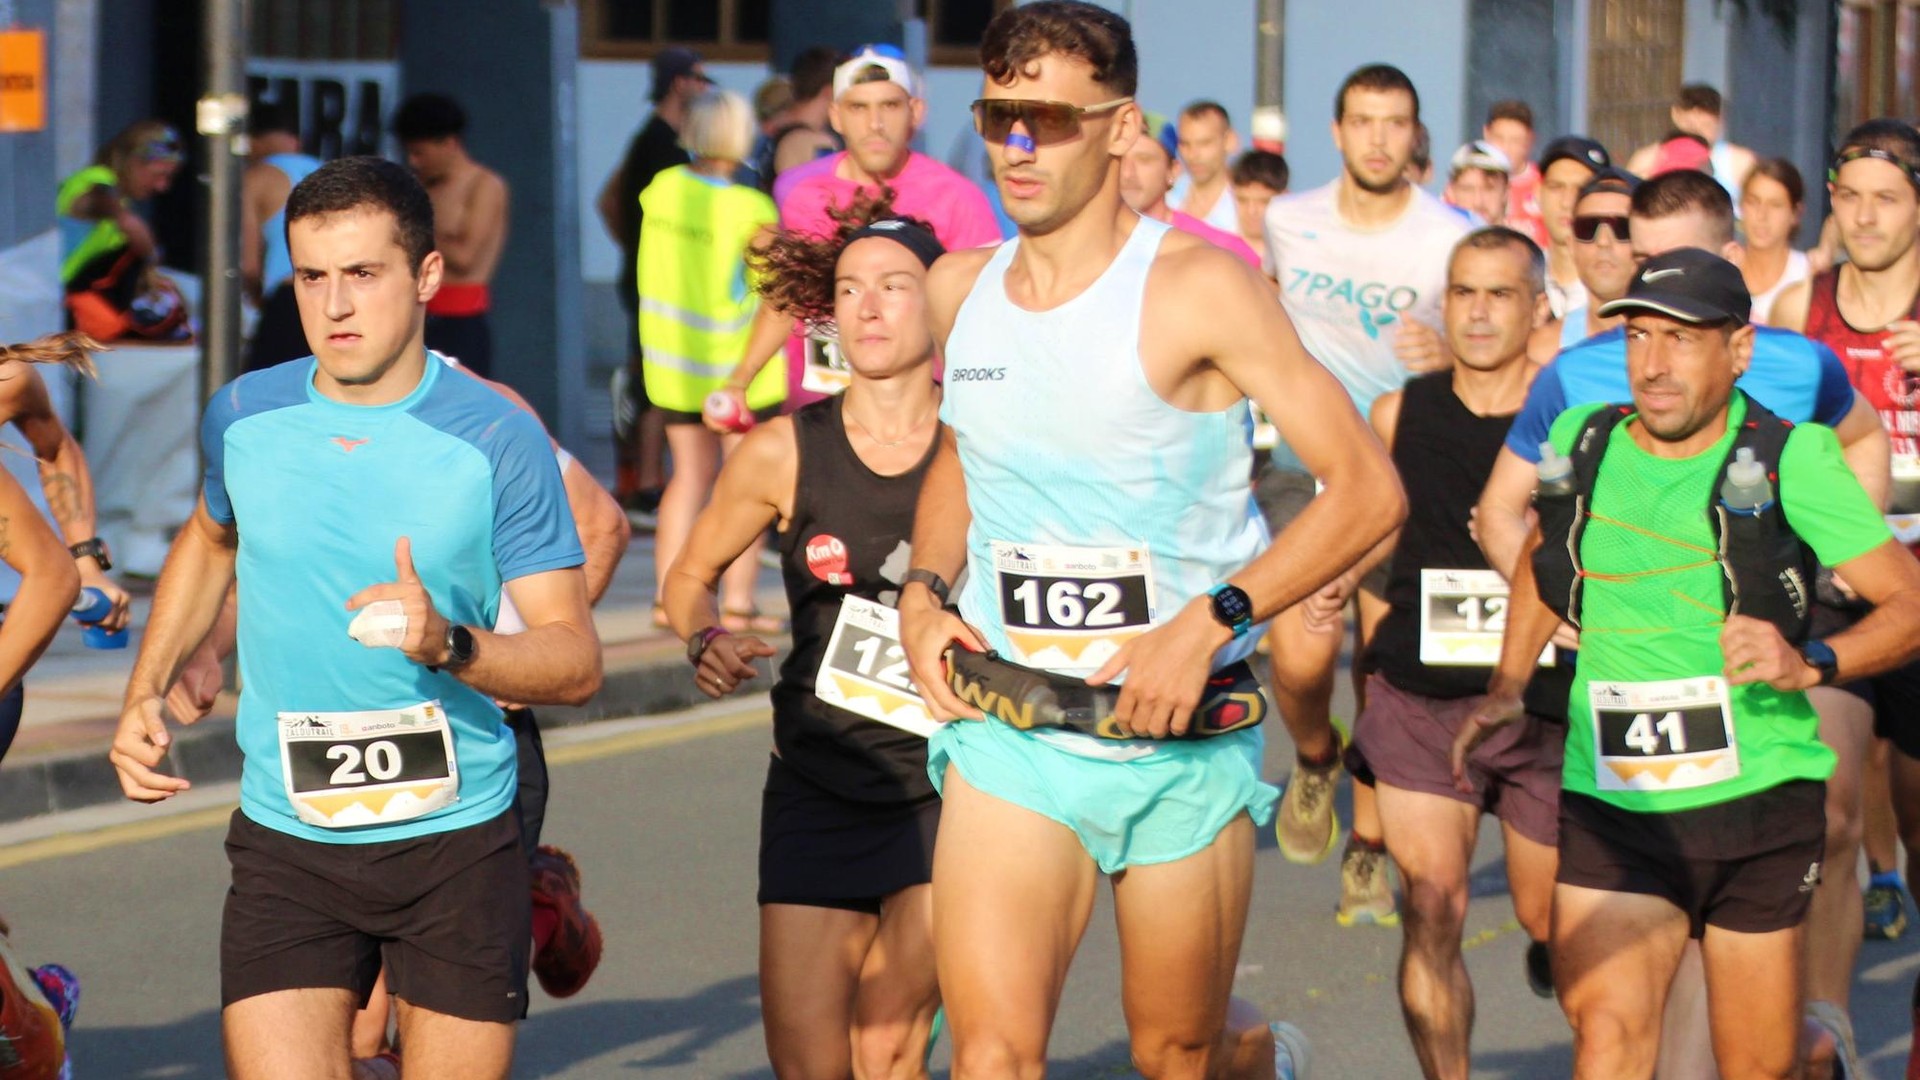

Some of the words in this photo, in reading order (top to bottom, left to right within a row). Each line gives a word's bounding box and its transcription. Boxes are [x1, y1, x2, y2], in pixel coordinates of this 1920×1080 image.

[951, 367, 1007, 382] BROOKS
[1013, 579, 1125, 627] 162
[853, 636, 919, 694] 12
[1624, 711, 1687, 755] 41
[325, 740, 402, 785] 20
